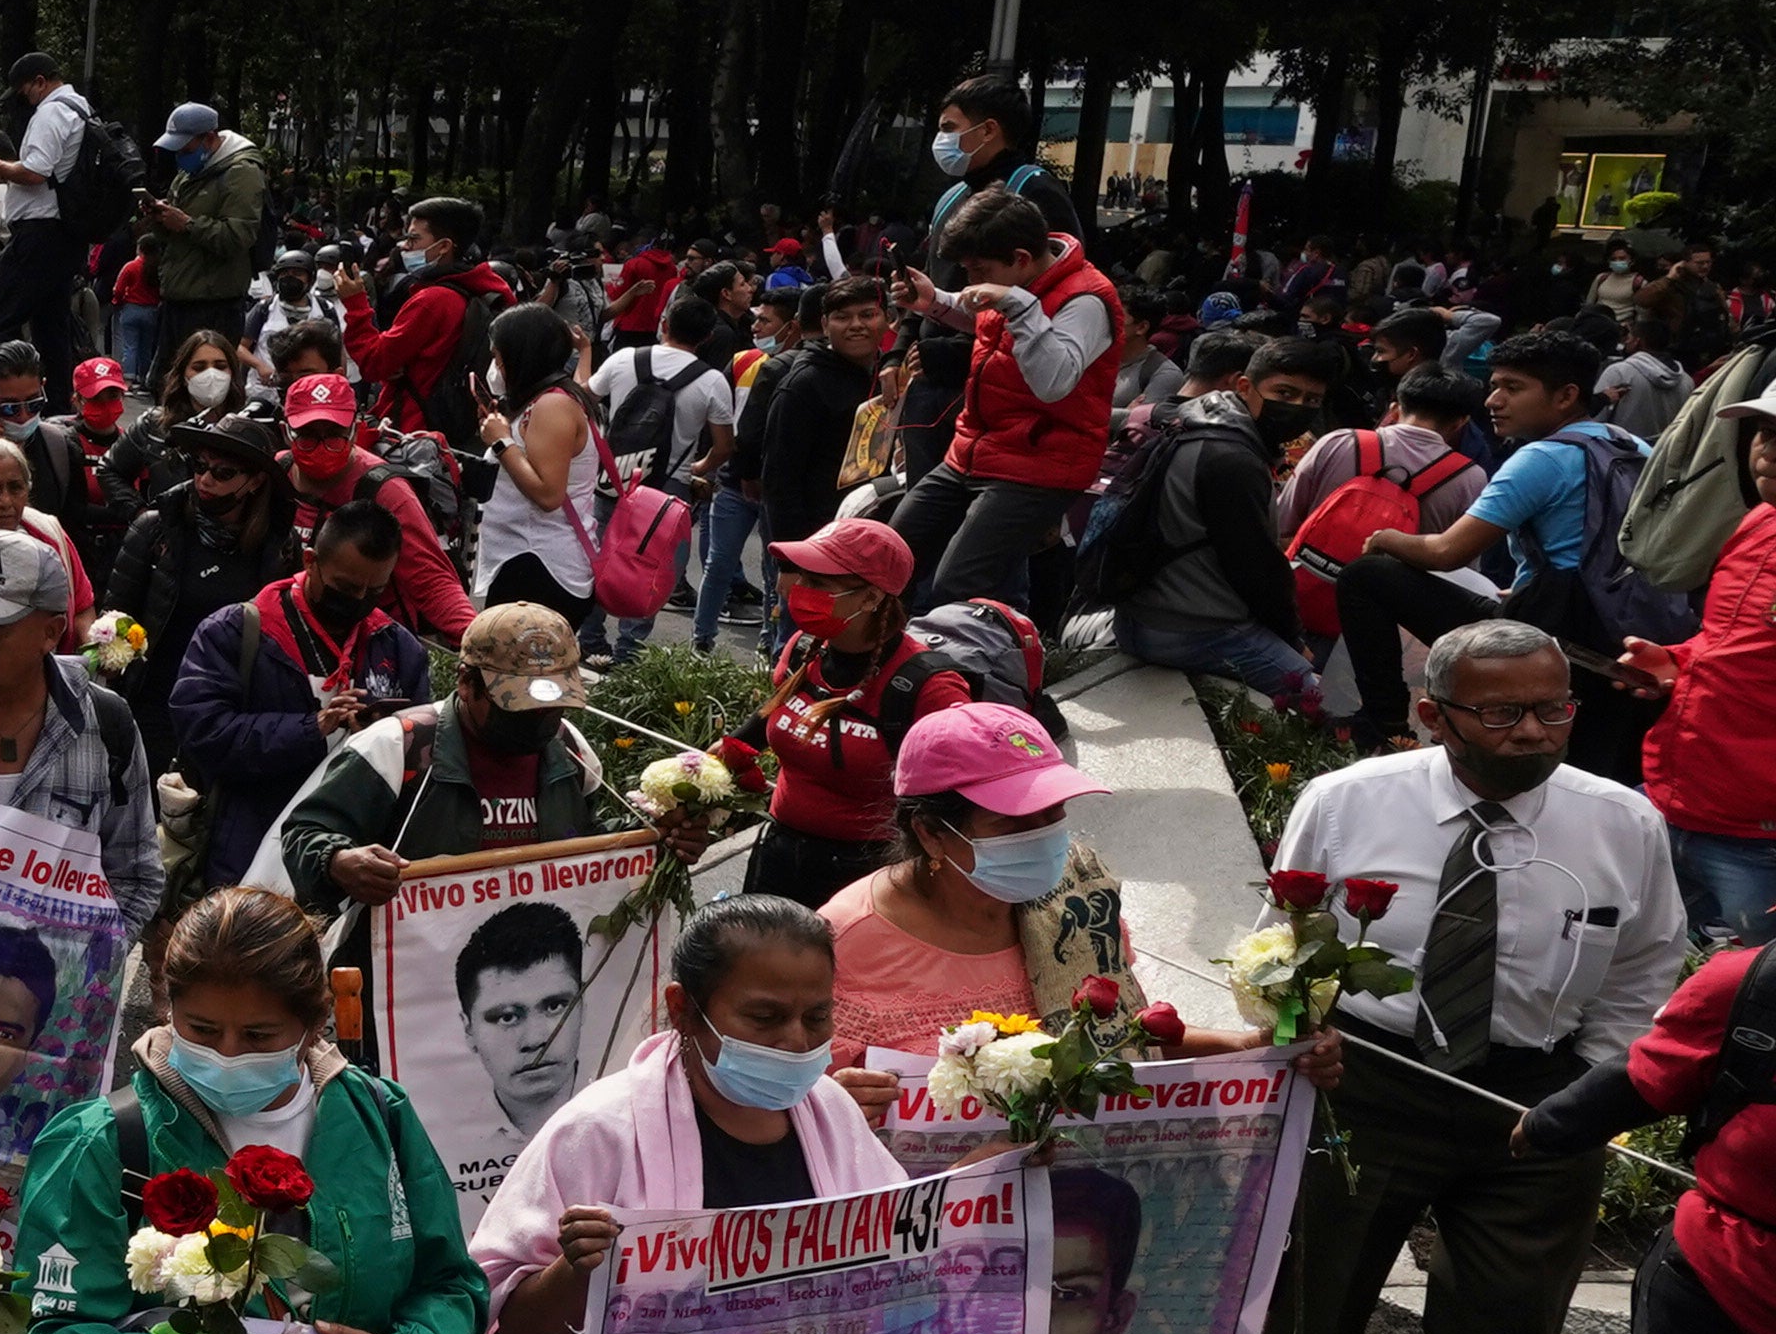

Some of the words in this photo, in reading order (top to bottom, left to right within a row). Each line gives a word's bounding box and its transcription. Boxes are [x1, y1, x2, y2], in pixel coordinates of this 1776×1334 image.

[21, 849, 52, 885] lo
[397, 882, 466, 921] ¡Vivo
[474, 878, 501, 904] se
[508, 869, 534, 897] lo
[542, 848, 654, 891] llevaron!
[708, 1207, 779, 1283] NOS
[782, 1188, 901, 1269] FALTAN
[893, 1173, 949, 1256] 43!
